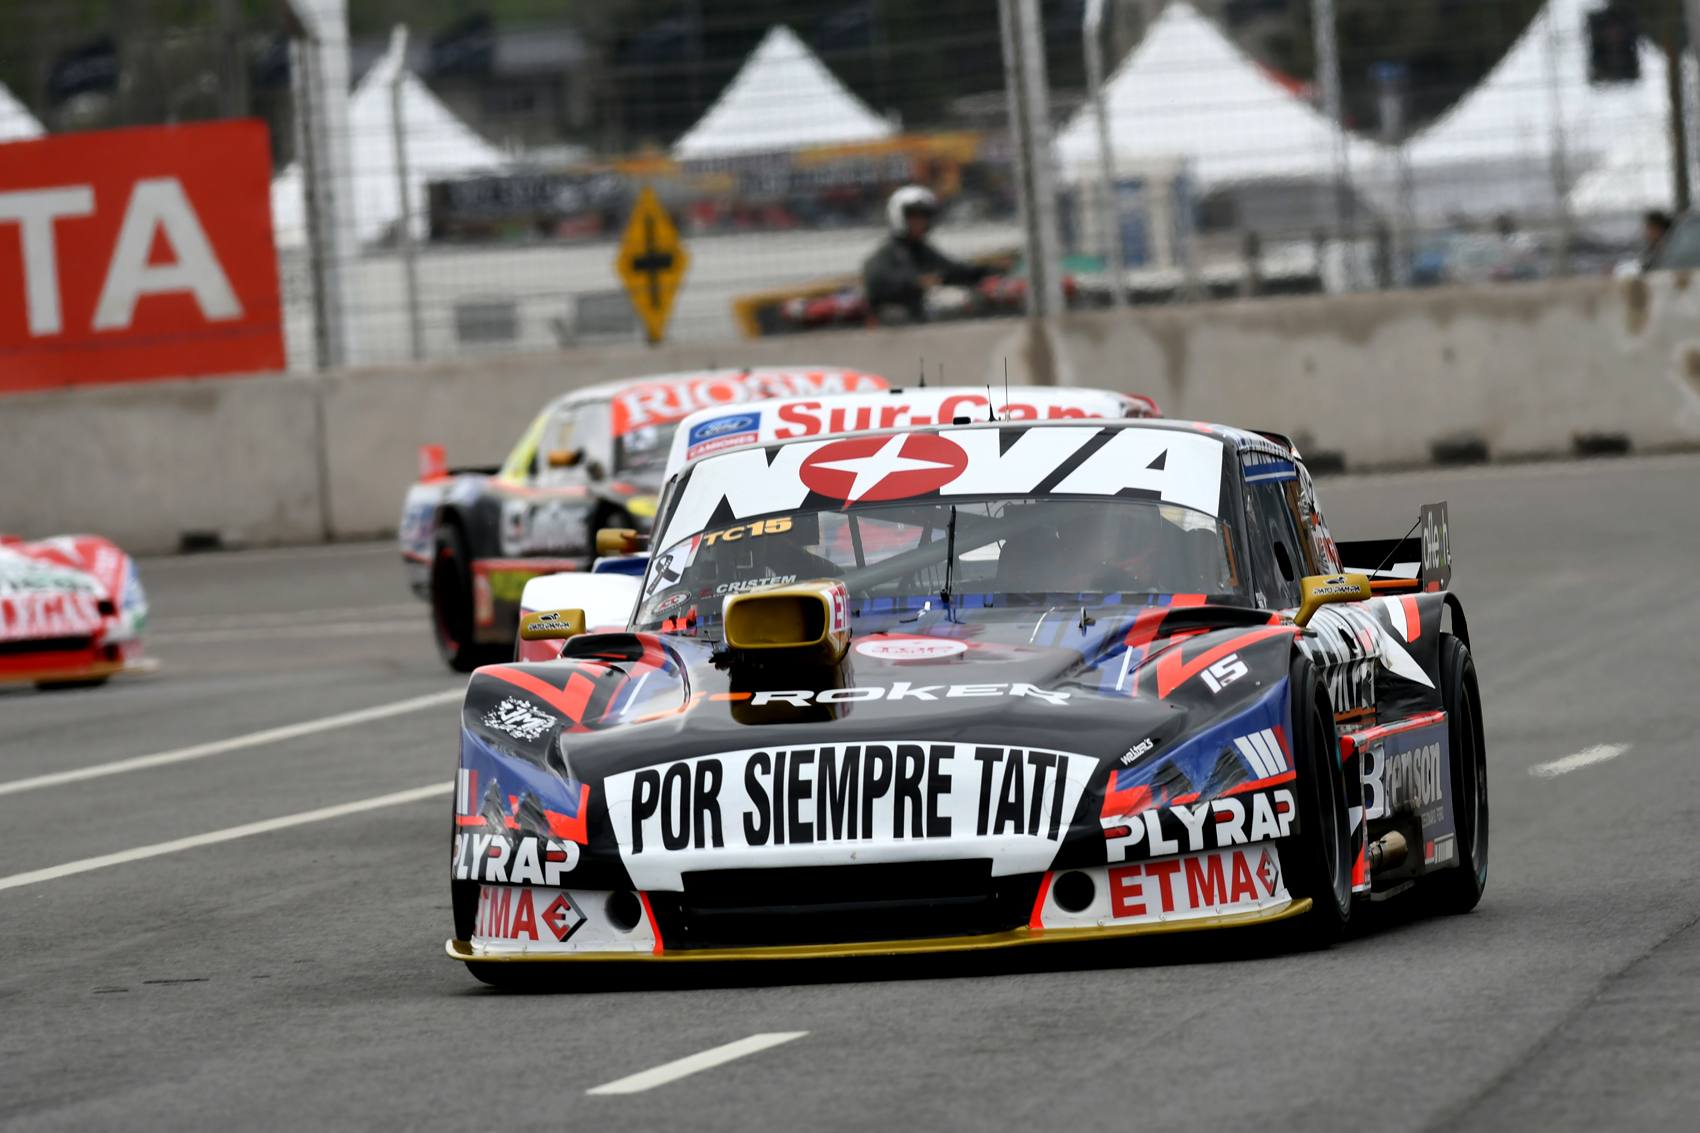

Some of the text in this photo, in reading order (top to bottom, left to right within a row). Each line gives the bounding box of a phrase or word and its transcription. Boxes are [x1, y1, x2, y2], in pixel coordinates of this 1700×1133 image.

[656, 426, 1224, 557] NOVA
[1200, 653, 1248, 694] 15
[632, 744, 1069, 854] POR SIEMPRE TATI
[1360, 742, 1443, 820] Brenson
[1100, 789, 1296, 863] PLYRAP
[475, 885, 539, 940] TMA
[1108, 851, 1259, 918] ETMA
